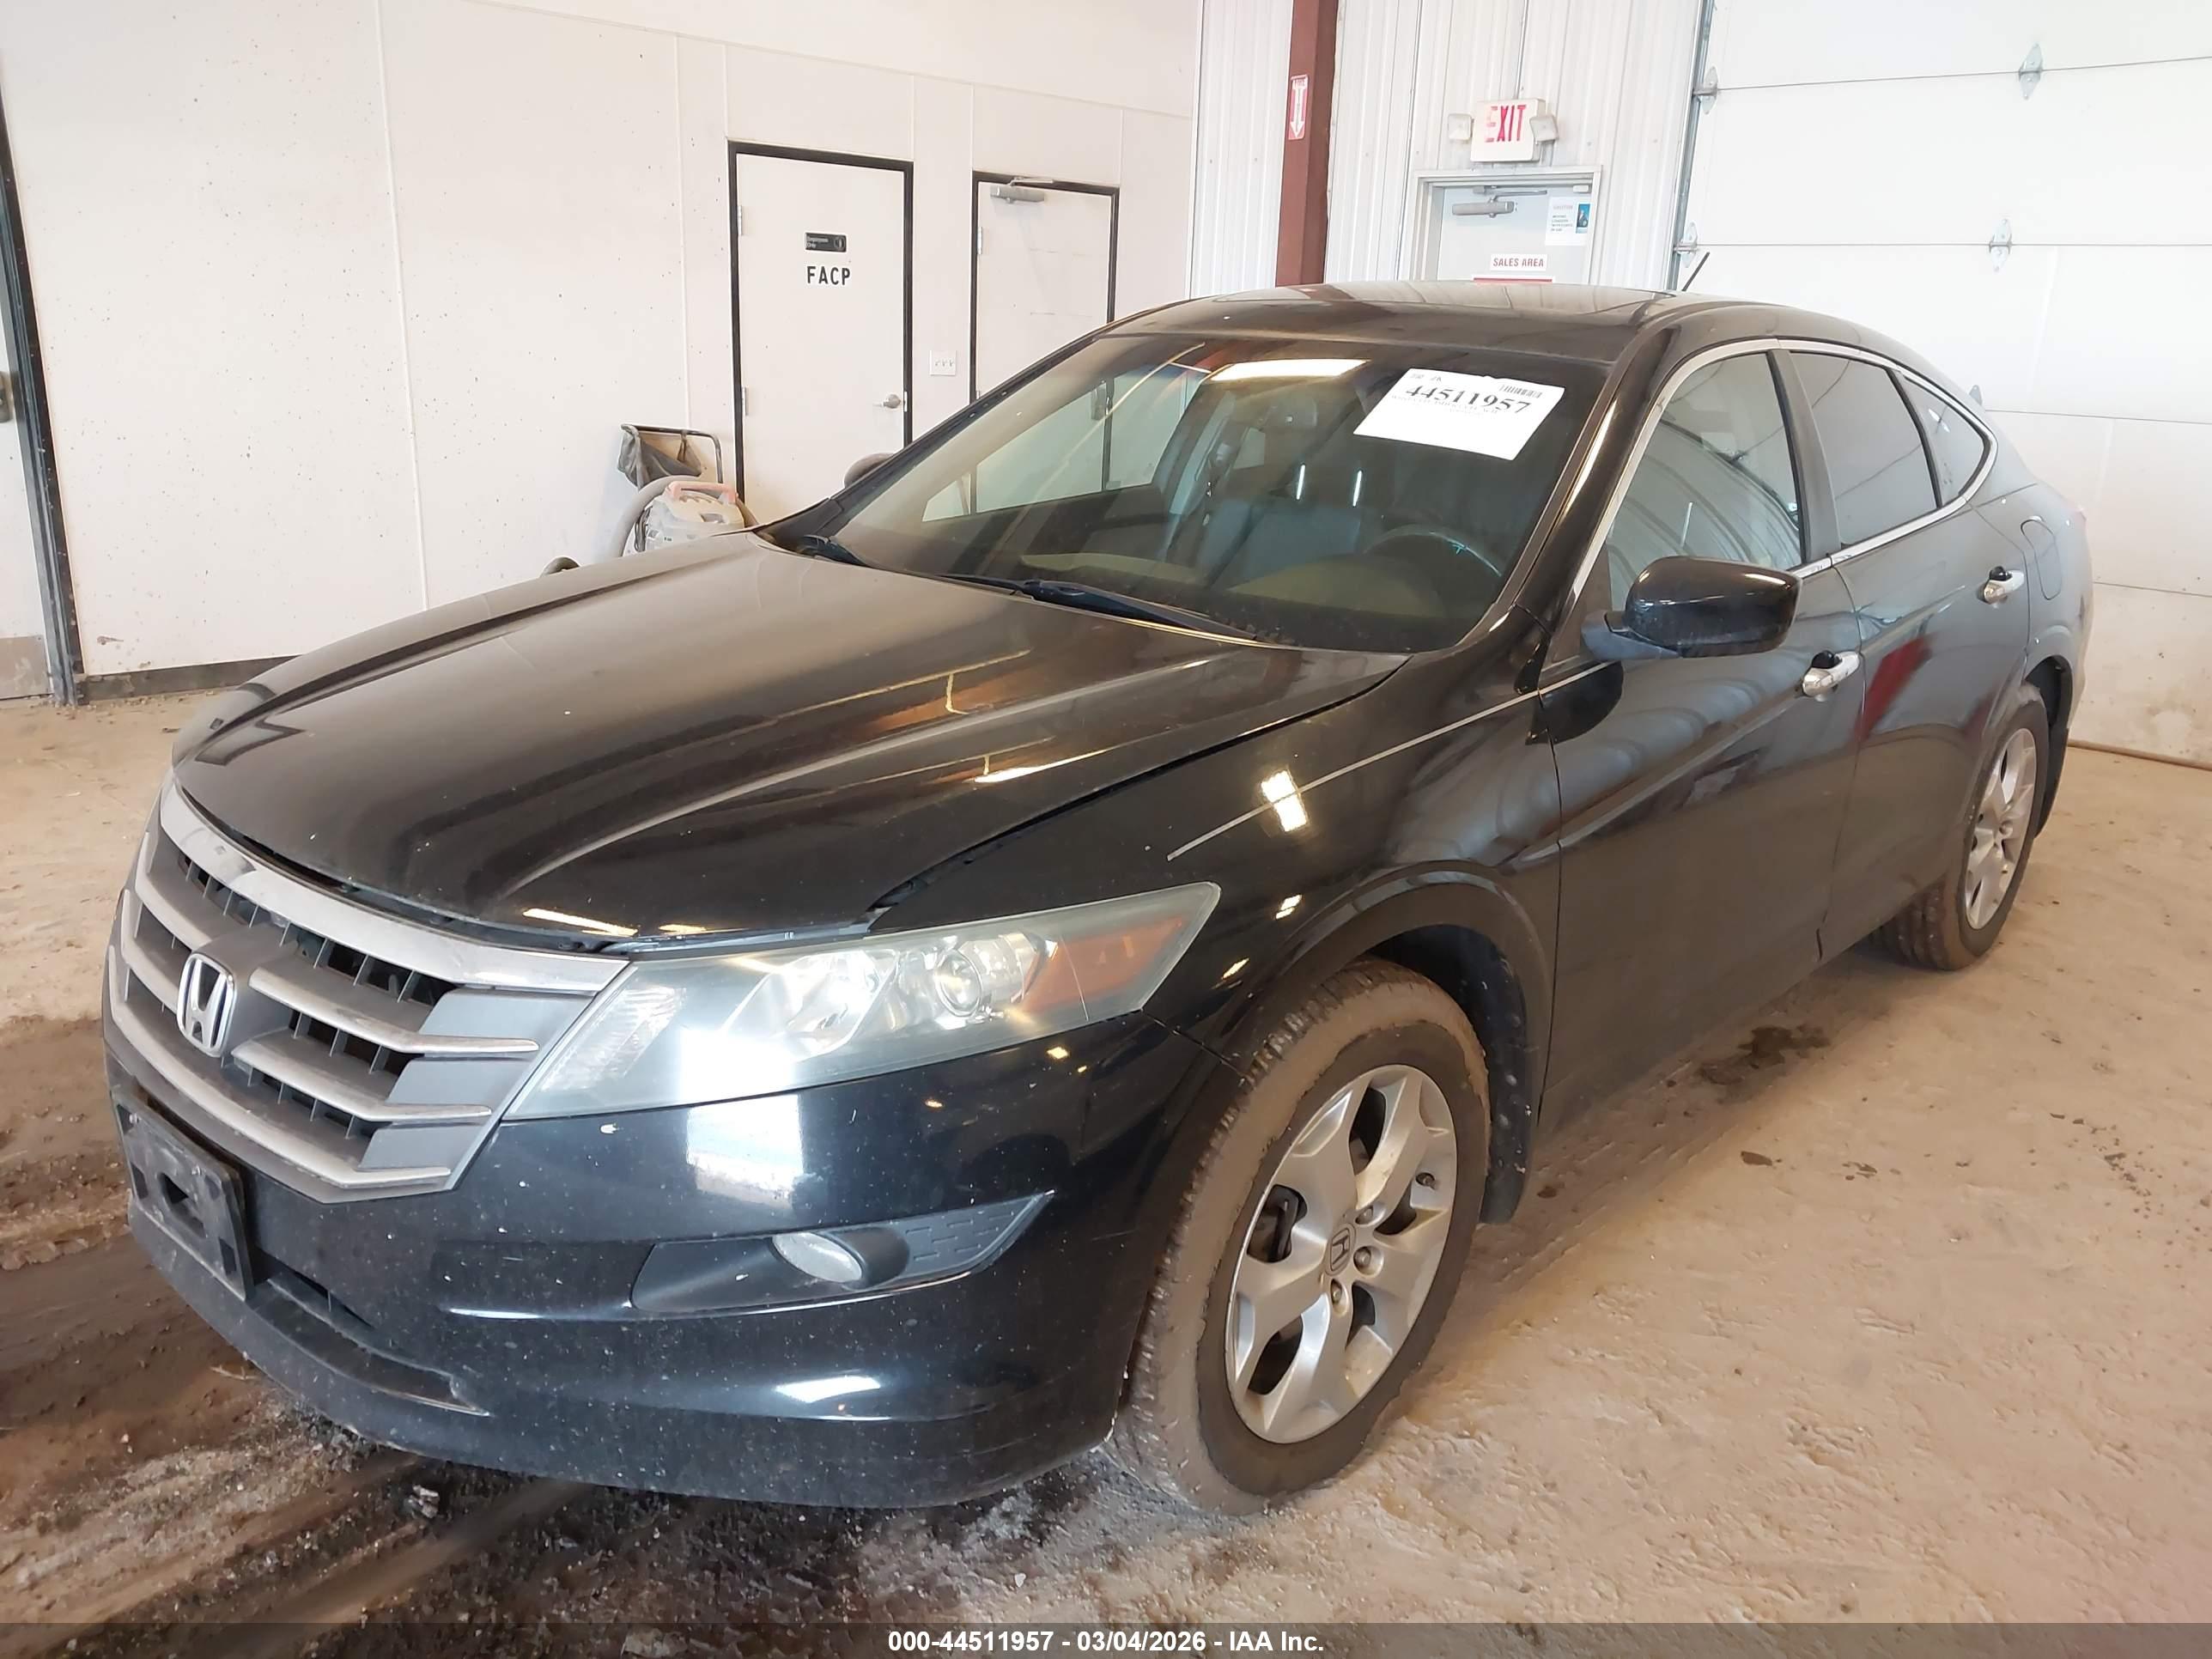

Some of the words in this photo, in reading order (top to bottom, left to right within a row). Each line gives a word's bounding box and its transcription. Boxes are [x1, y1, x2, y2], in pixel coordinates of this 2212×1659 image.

[1485, 105, 1527, 143] EXIT
[1492, 258, 1519, 267] SALES
[1522, 258, 1544, 267] AREA
[806, 265, 851, 286] FACP
[1405, 385, 1531, 414] 44511957
